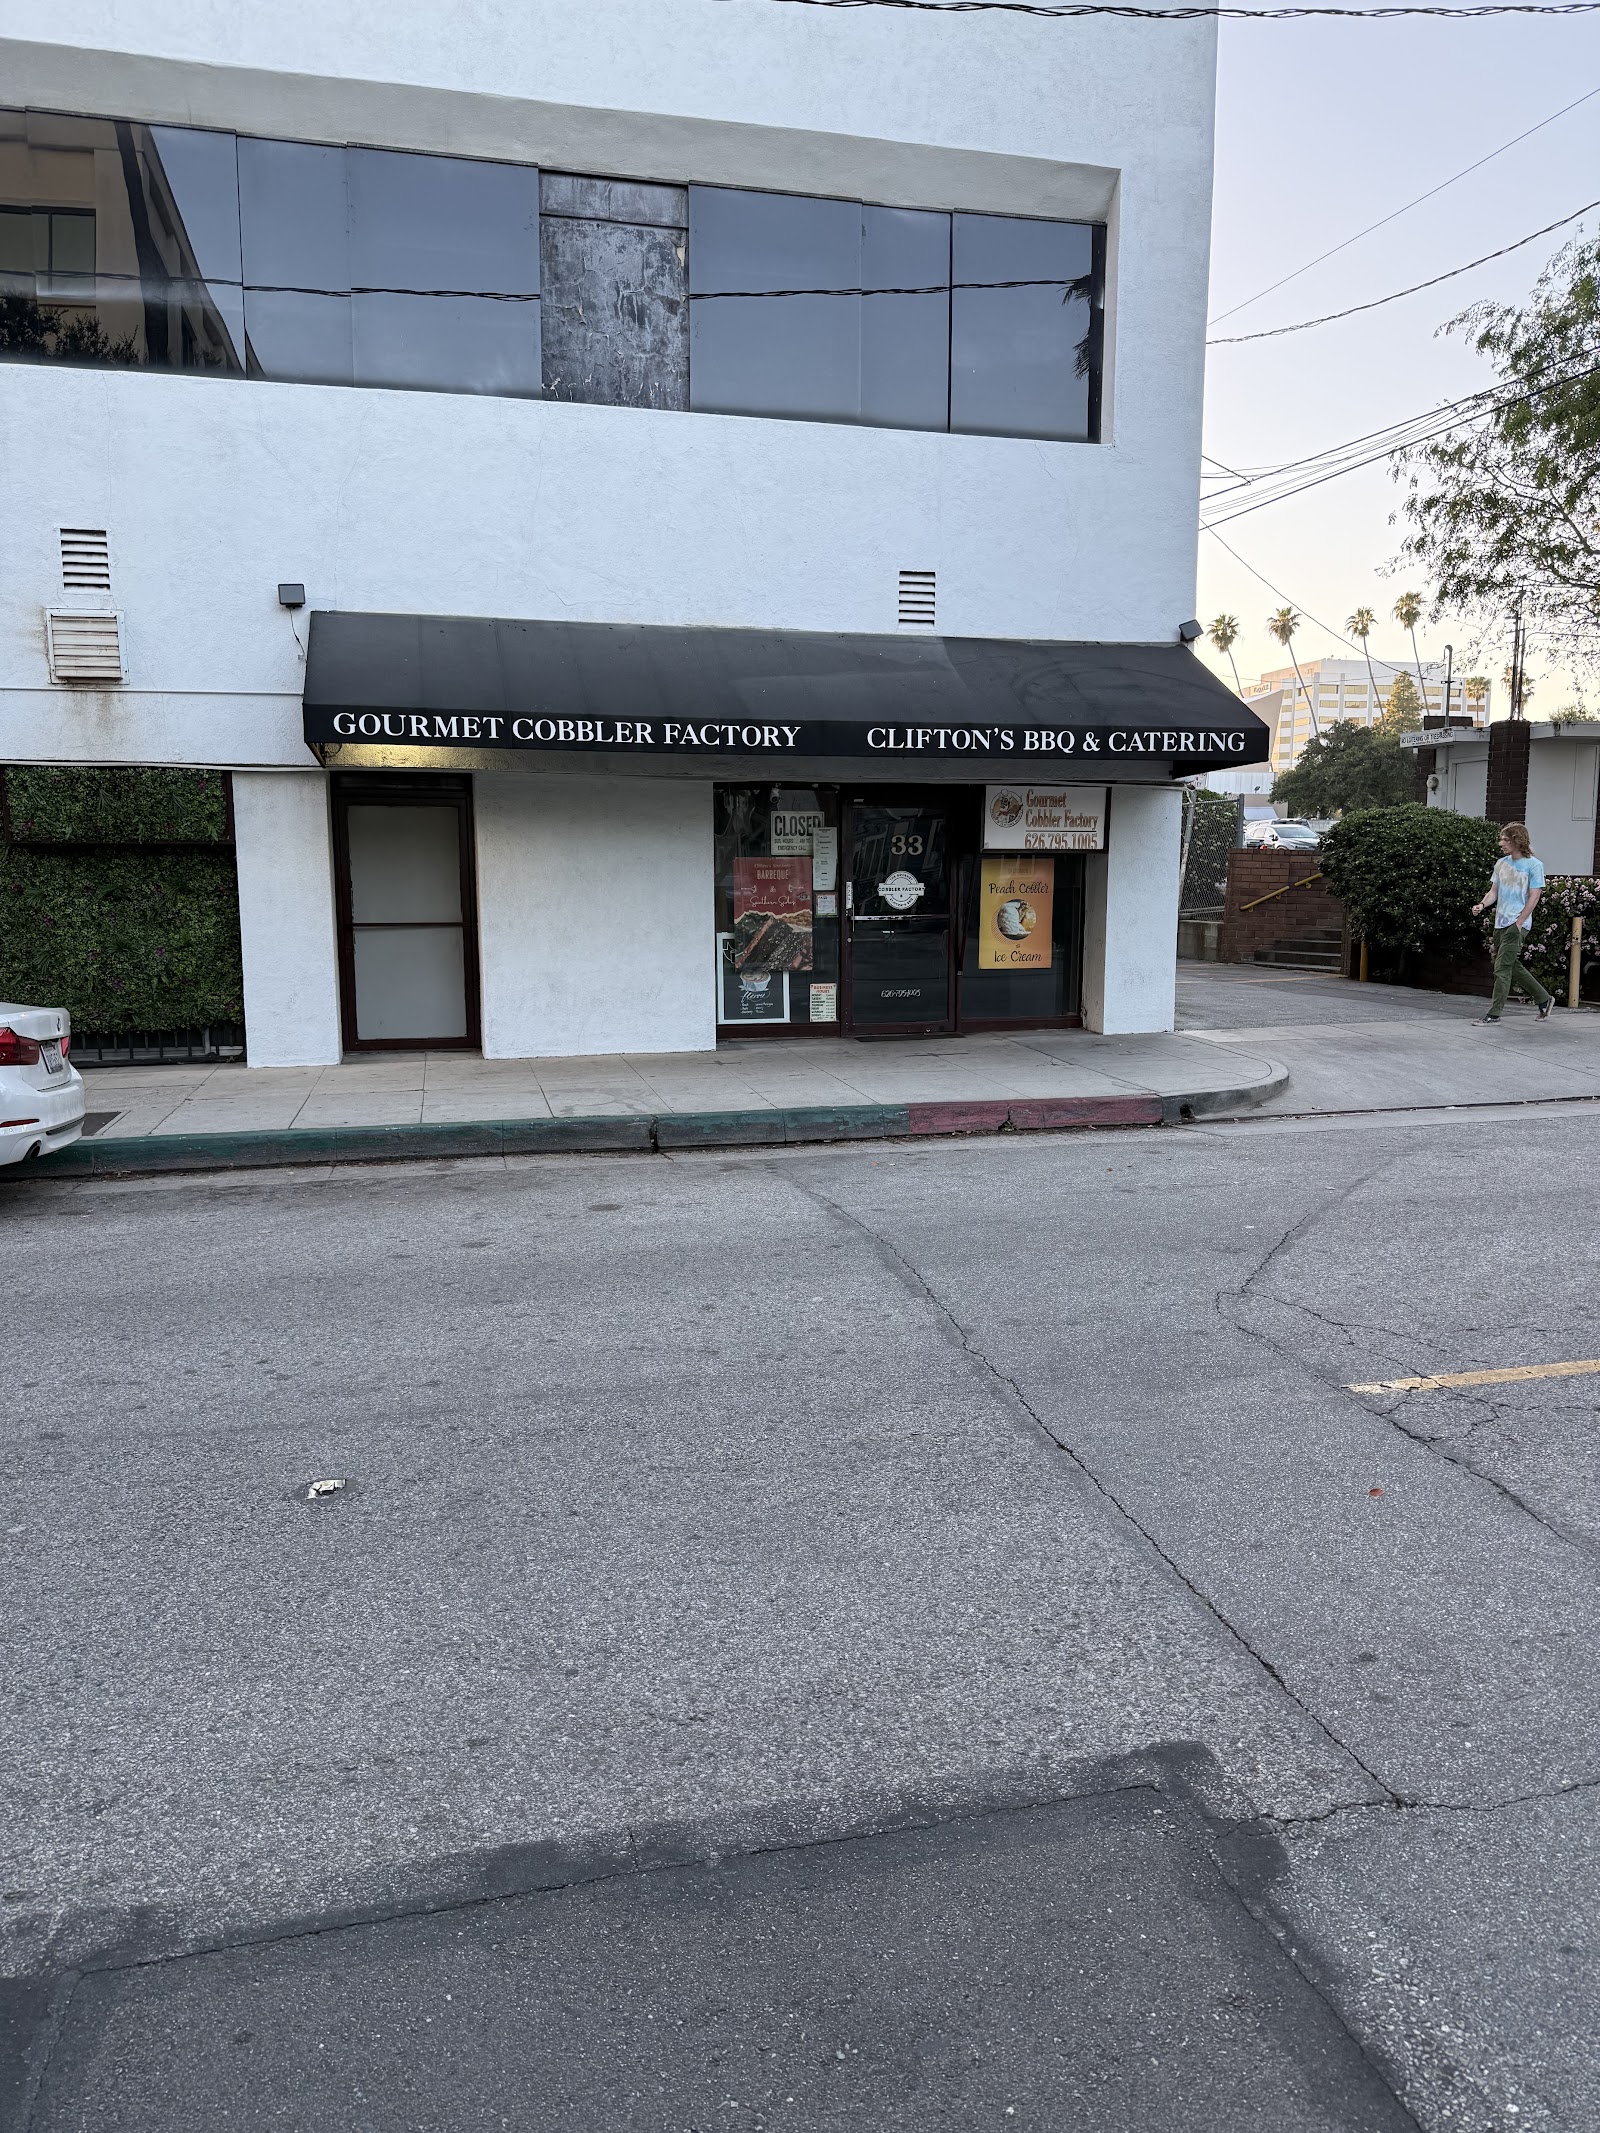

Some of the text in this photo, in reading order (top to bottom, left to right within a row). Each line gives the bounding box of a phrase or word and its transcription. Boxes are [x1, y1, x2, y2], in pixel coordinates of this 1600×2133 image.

[332, 711, 802, 747] GOURMET COBBLER FACTORY
[867, 727, 1246, 754] CLIFTON'S BBQ & CATERING
[1026, 789, 1067, 808] Gourmet
[774, 815, 822, 837] CLOSED
[1025, 809, 1062, 828] Cobbler
[1064, 809, 1099, 831] Factory
[891, 834, 923, 855] 33
[1024, 832, 1098, 850] 626.795.1005
[756, 869, 789, 880] BARBEQUE
[988, 879, 1050, 894] Peach Cobbler
[749, 895, 777, 908] Southern
[994, 950, 1043, 963] Ice Cream
